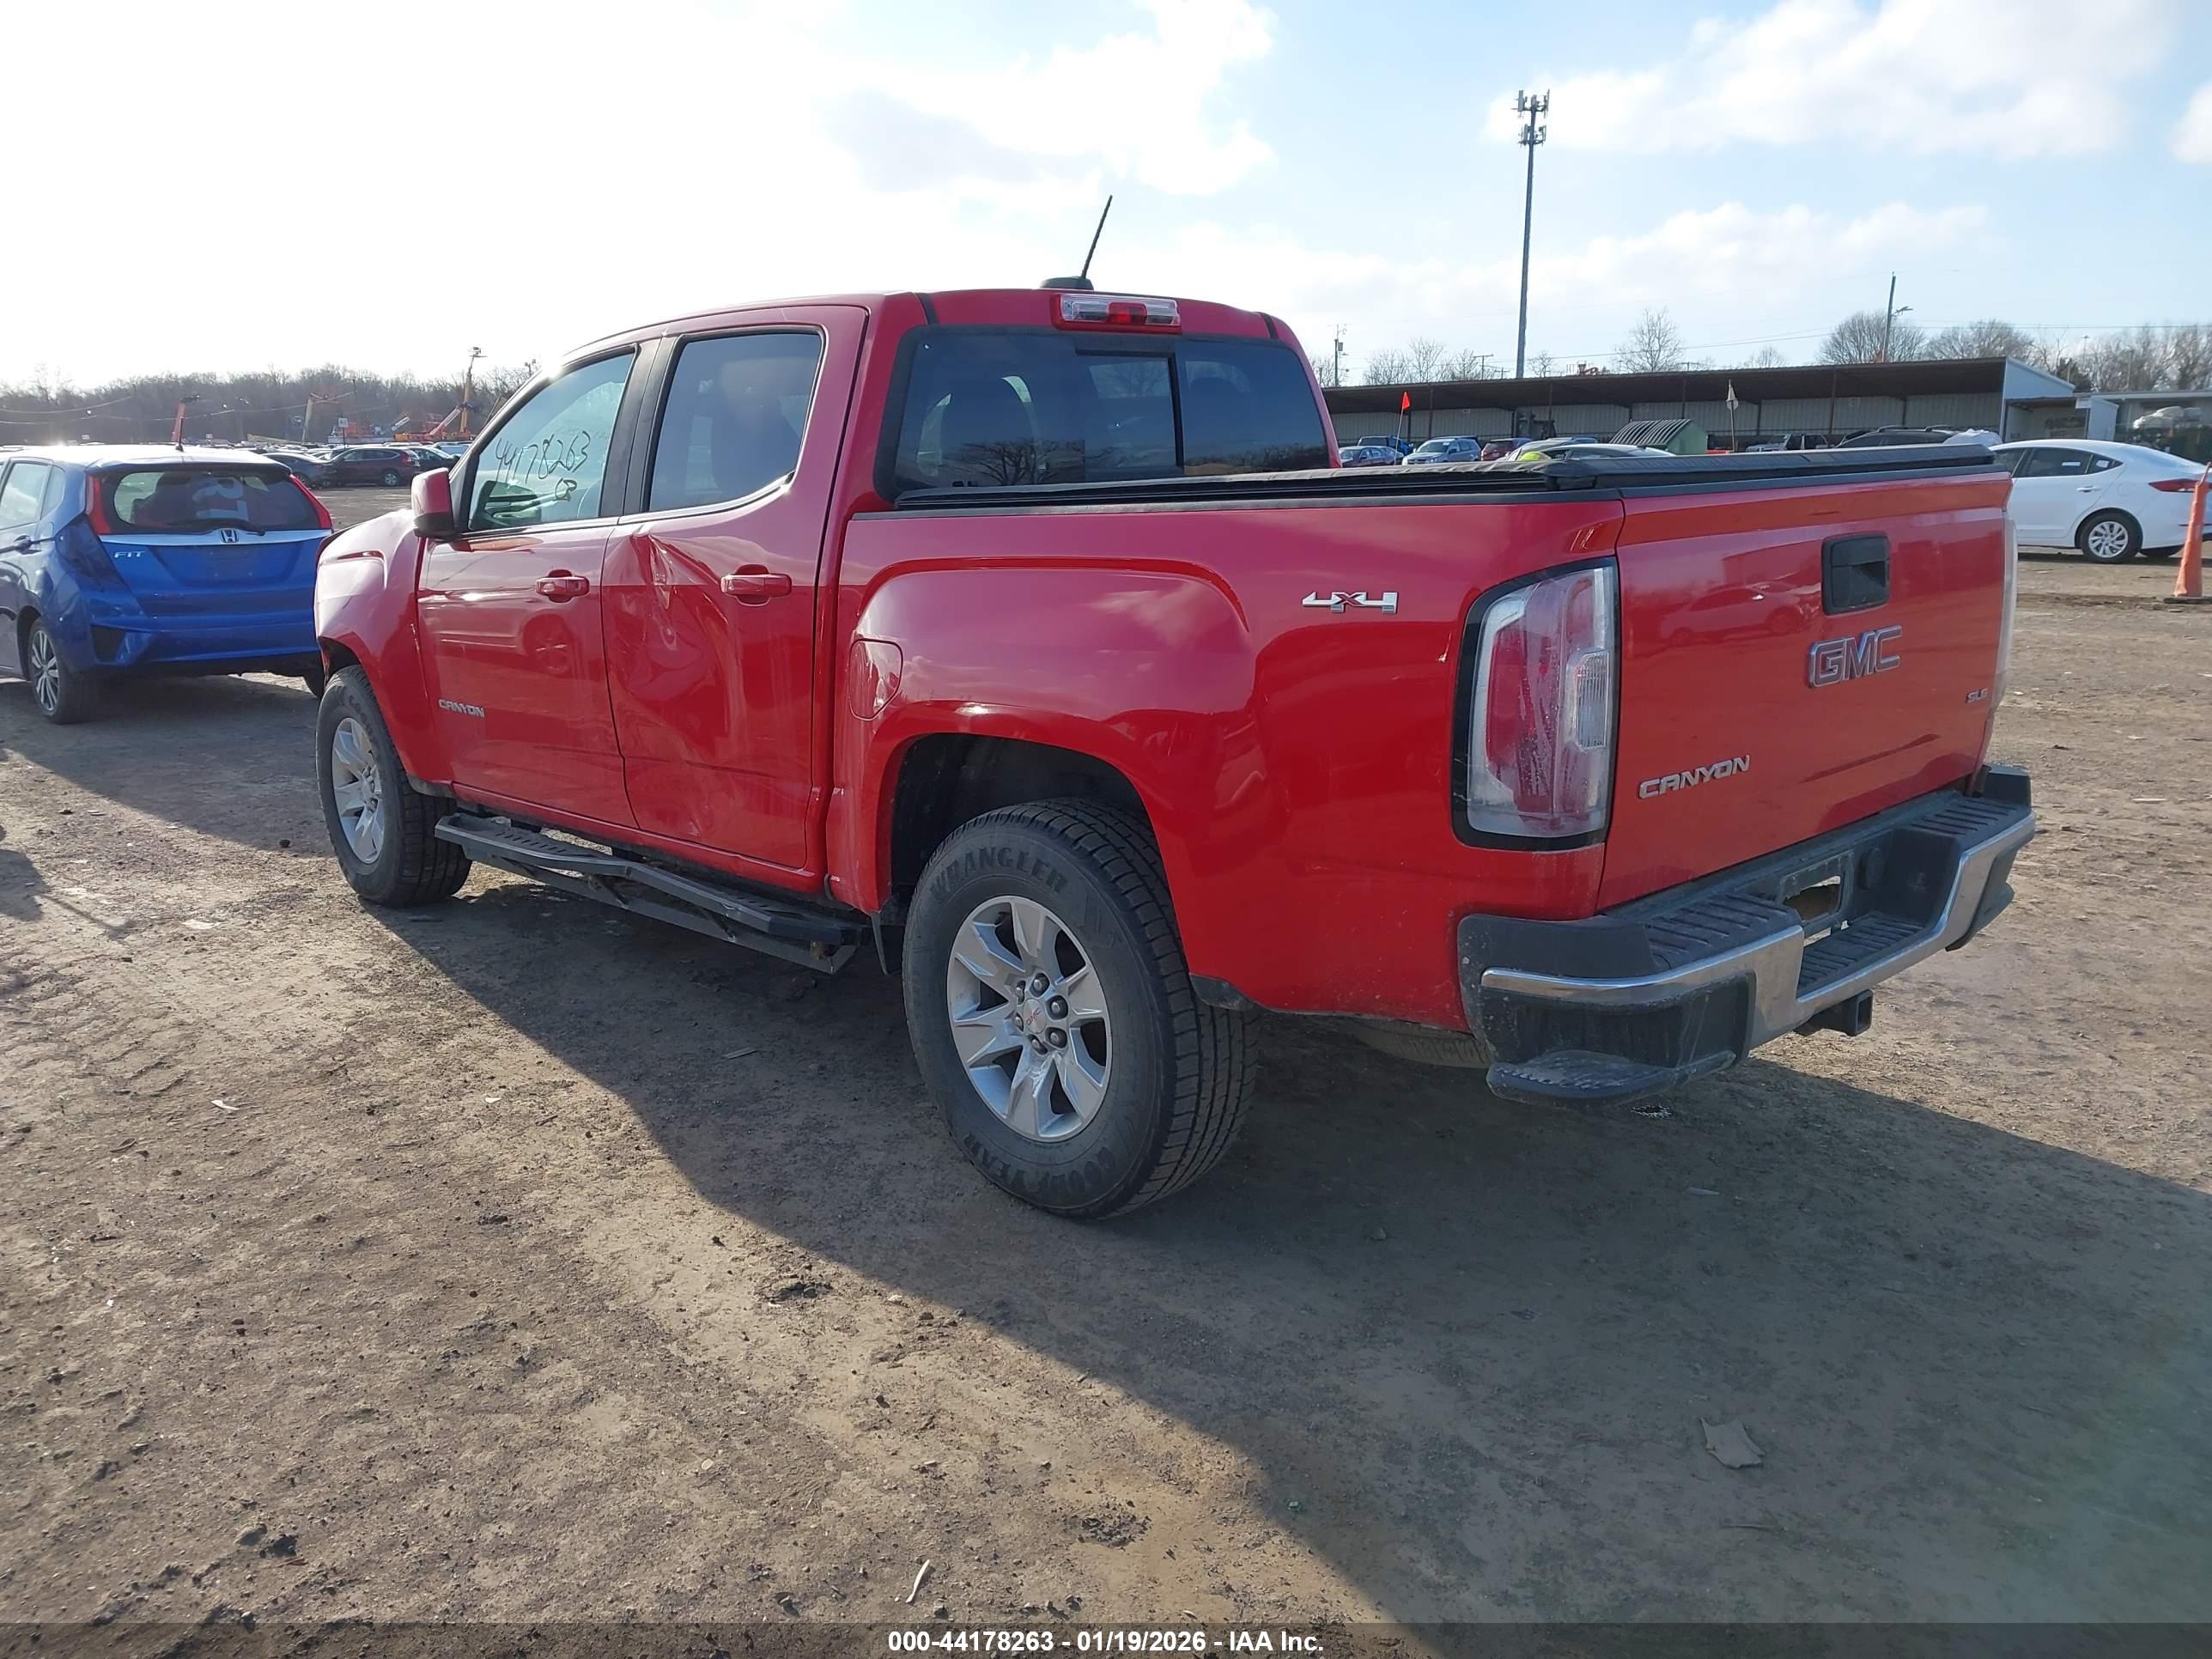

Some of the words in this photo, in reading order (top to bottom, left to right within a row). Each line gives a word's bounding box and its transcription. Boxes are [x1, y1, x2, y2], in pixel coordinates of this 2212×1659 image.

[495, 430, 591, 484] 44178263
[1809, 625, 1901, 688] GMC
[438, 699, 485, 718] CANYON
[1639, 755, 1750, 799] CANYON
[929, 846, 1068, 899] WRANGLER
